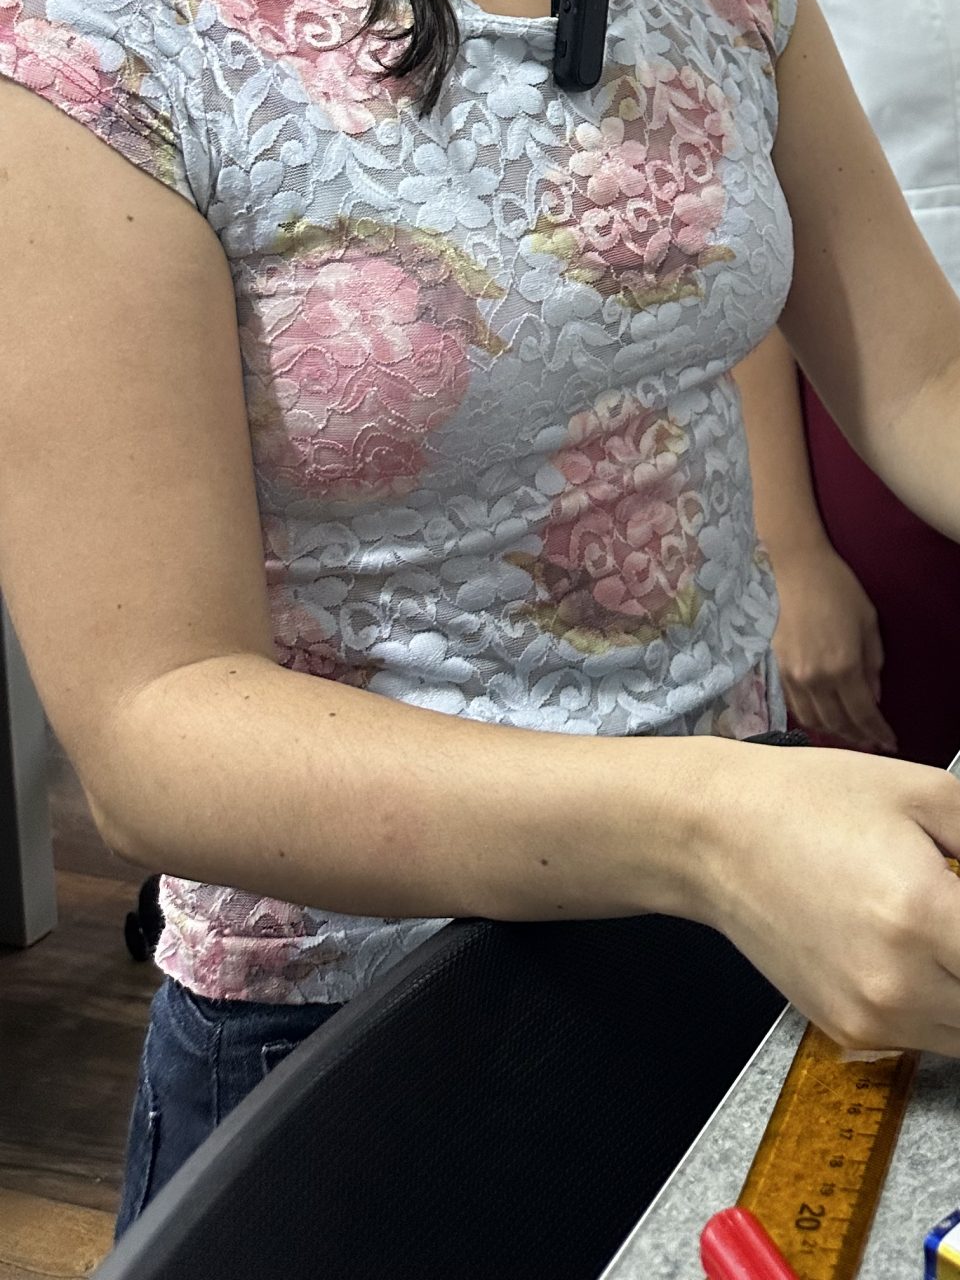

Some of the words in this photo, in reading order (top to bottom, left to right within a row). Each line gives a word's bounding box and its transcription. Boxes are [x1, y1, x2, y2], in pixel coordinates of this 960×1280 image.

[839, 1128, 854, 1140] 17
[829, 1155, 845, 1168] 18
[795, 1203, 826, 1231] 20
